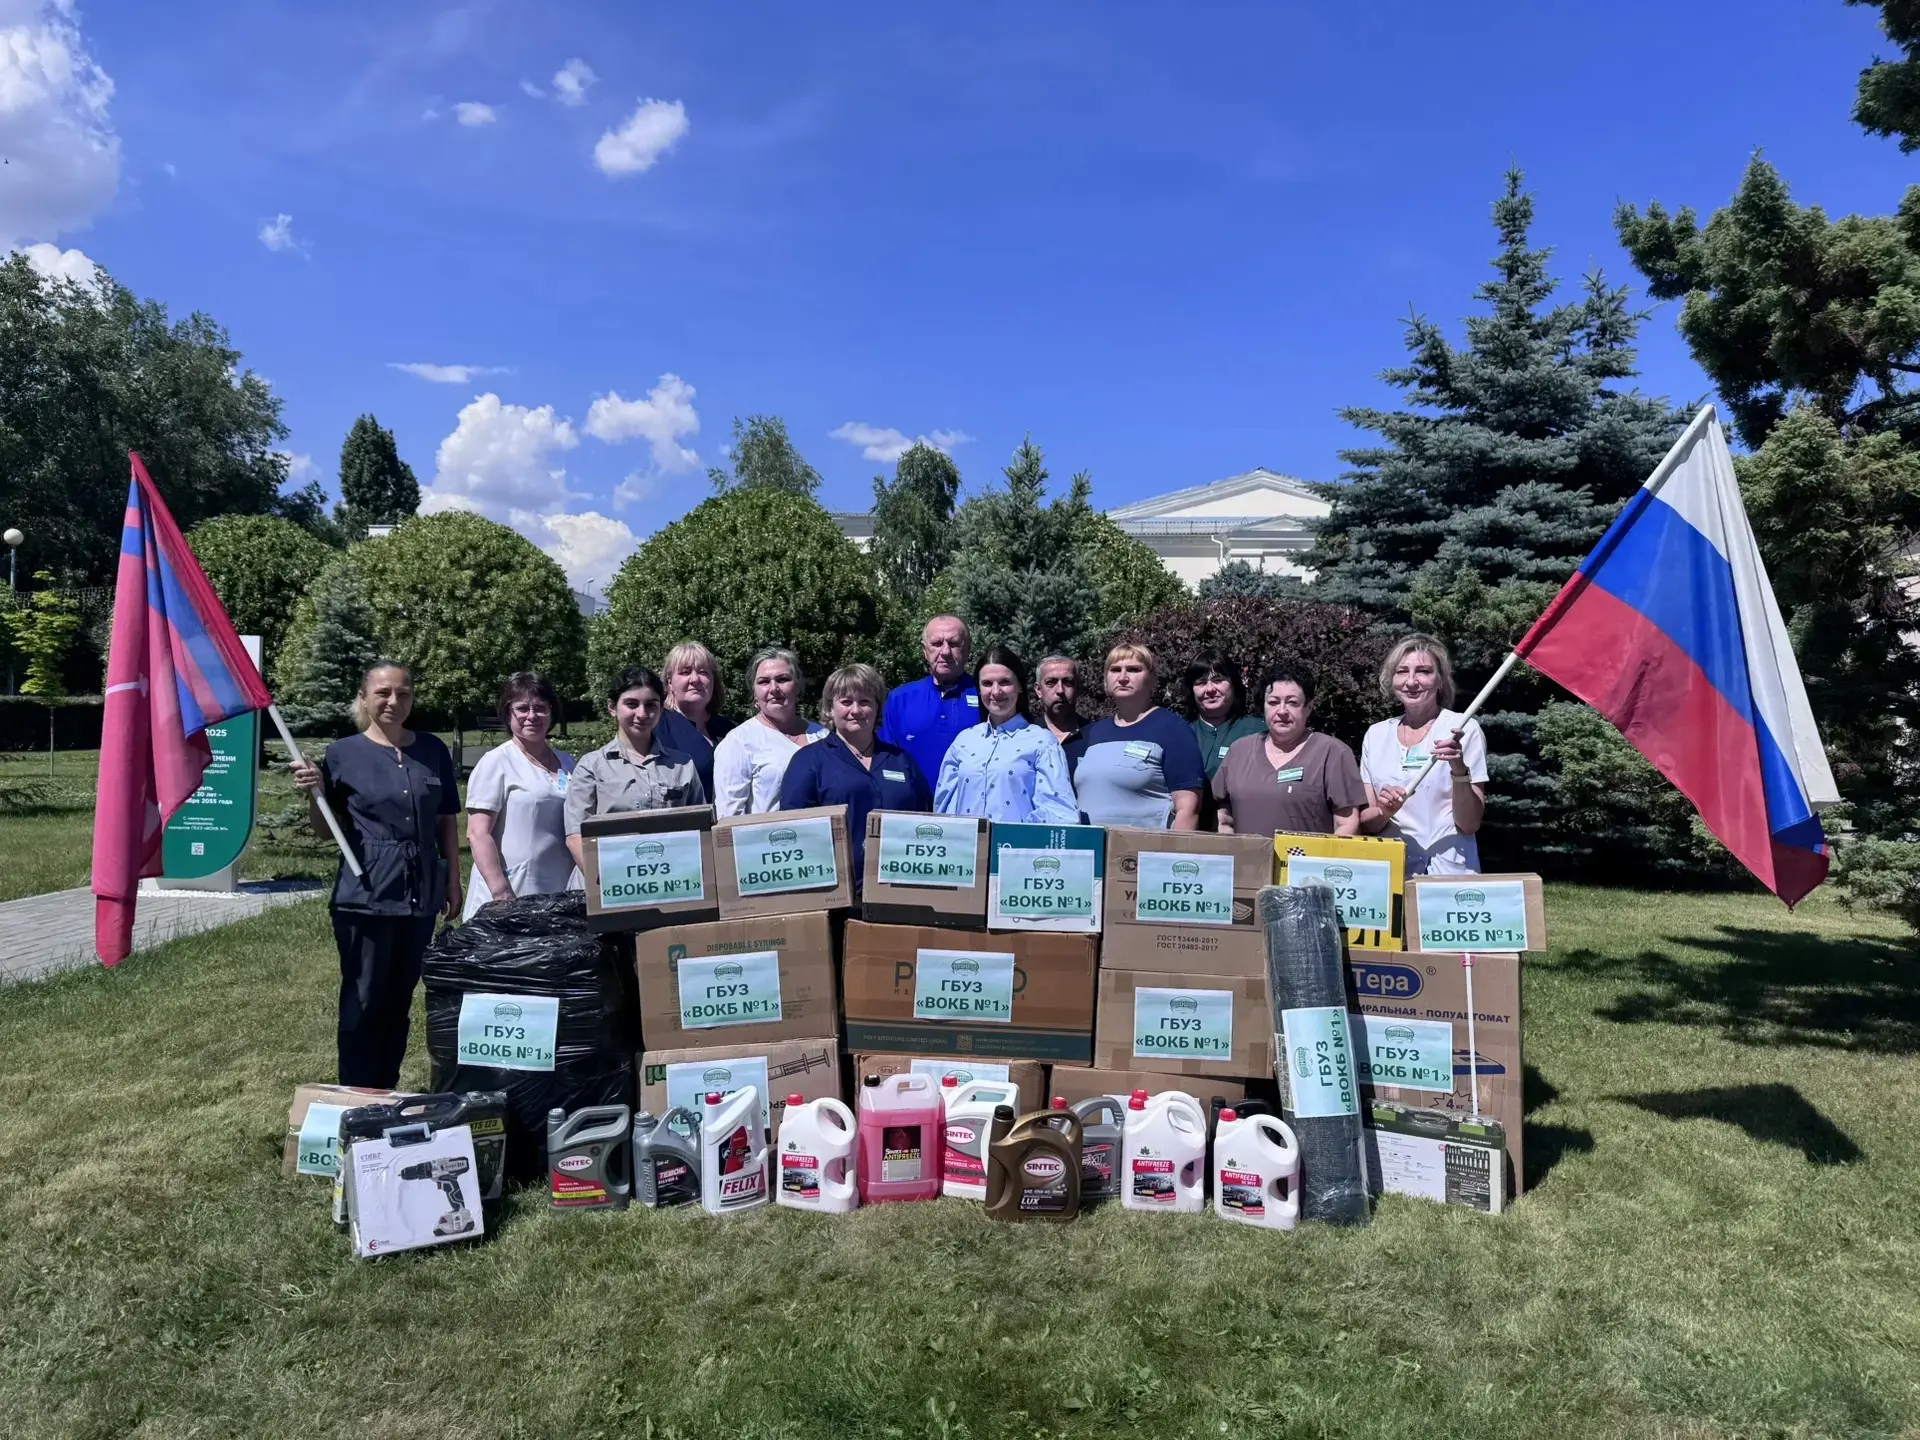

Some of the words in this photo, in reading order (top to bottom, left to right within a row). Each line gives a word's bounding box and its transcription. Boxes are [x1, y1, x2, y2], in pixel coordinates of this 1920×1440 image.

[205, 728, 227, 737] 2025
[761, 849, 804, 865] ГБУЗ
[905, 844, 947, 858] ГБУЗ
[626, 862, 671, 878] ГБУЗ
[739, 867, 794, 885] «ВОКБ
[797, 864, 834, 878] №1»
[881, 861, 934, 875] «ВОКБ
[938, 863, 974, 876] №1»
[603, 881, 659, 897] «ВОКБ
[663, 879, 701, 892] №1»
[1024, 878, 1065, 891] ГБУЗ
[1162, 882, 1204, 895] ГБУЗ
[1335, 887, 1357, 900] УЗ
[1000, 895, 1053, 908] «ВОКБ
[1057, 896, 1092, 909] №1»
[1138, 899, 1191, 912] «ВОКБ
[1195, 901, 1231, 914] №1»
[1349, 905, 1387, 920] №1»
[1446, 911, 1492, 924] ГБУЗ
[1156, 934, 1176, 942] ГОСТ
[1421, 929, 1480, 942] «ВОКБ
[1485, 929, 1525, 942] №1»
[706, 940, 752, 952] DISPOSABLE
[753, 937, 787, 948] SYRINGE
[1156, 941, 1176, 949] ГОСТ
[706, 983, 749, 999] ГБУЗ
[941, 979, 983, 993] ГБУЗ
[683, 1002, 738, 1019] «ВОКБ
[742, 999, 779, 1013] №1»
[916, 996, 970, 1011] «ВОКБ
[974, 998, 1010, 1012] №1»
[1351, 1004, 1417, 1016] ТИРАЛЬНАЯ
[1160, 1017, 1202, 1031] ГБУЗ
[484, 1024, 526, 1040] ГБУЗ
[1135, 1035, 1189, 1049] «ВОКБ
[1194, 1037, 1230, 1050] №1»
[460, 1042, 512, 1058] «ВОКБ
[516, 1046, 553, 1061] №1»
[1375, 1046, 1420, 1061] ГБУЗ
[1315, 1040, 1333, 1087] ГБУЗ
[1412, 1067, 1451, 1082] №1»
[1335, 1053, 1352, 1112] «ВОКБ
[1446, 1099, 1454, 1110] 4
[484, 1119, 498, 1128] 123
[945, 1130, 974, 1140] SINTEC
[300, 1152, 338, 1166] «ВО
[785, 1155, 814, 1164] ANTIFREEZE
[884, 1152, 920, 1160] ANTIFREEZE
[561, 1159, 591, 1168] SINTEC
[1026, 1163, 1060, 1171] SINTEC
[1136, 1160, 1170, 1168] ANTIFREEZE
[659, 1167, 686, 1179] TEBOIL
[1224, 1171, 1258, 1182] ANTIFREEZE
[723, 1175, 758, 1195] FELIX
[1021, 1197, 1040, 1205] LUX
